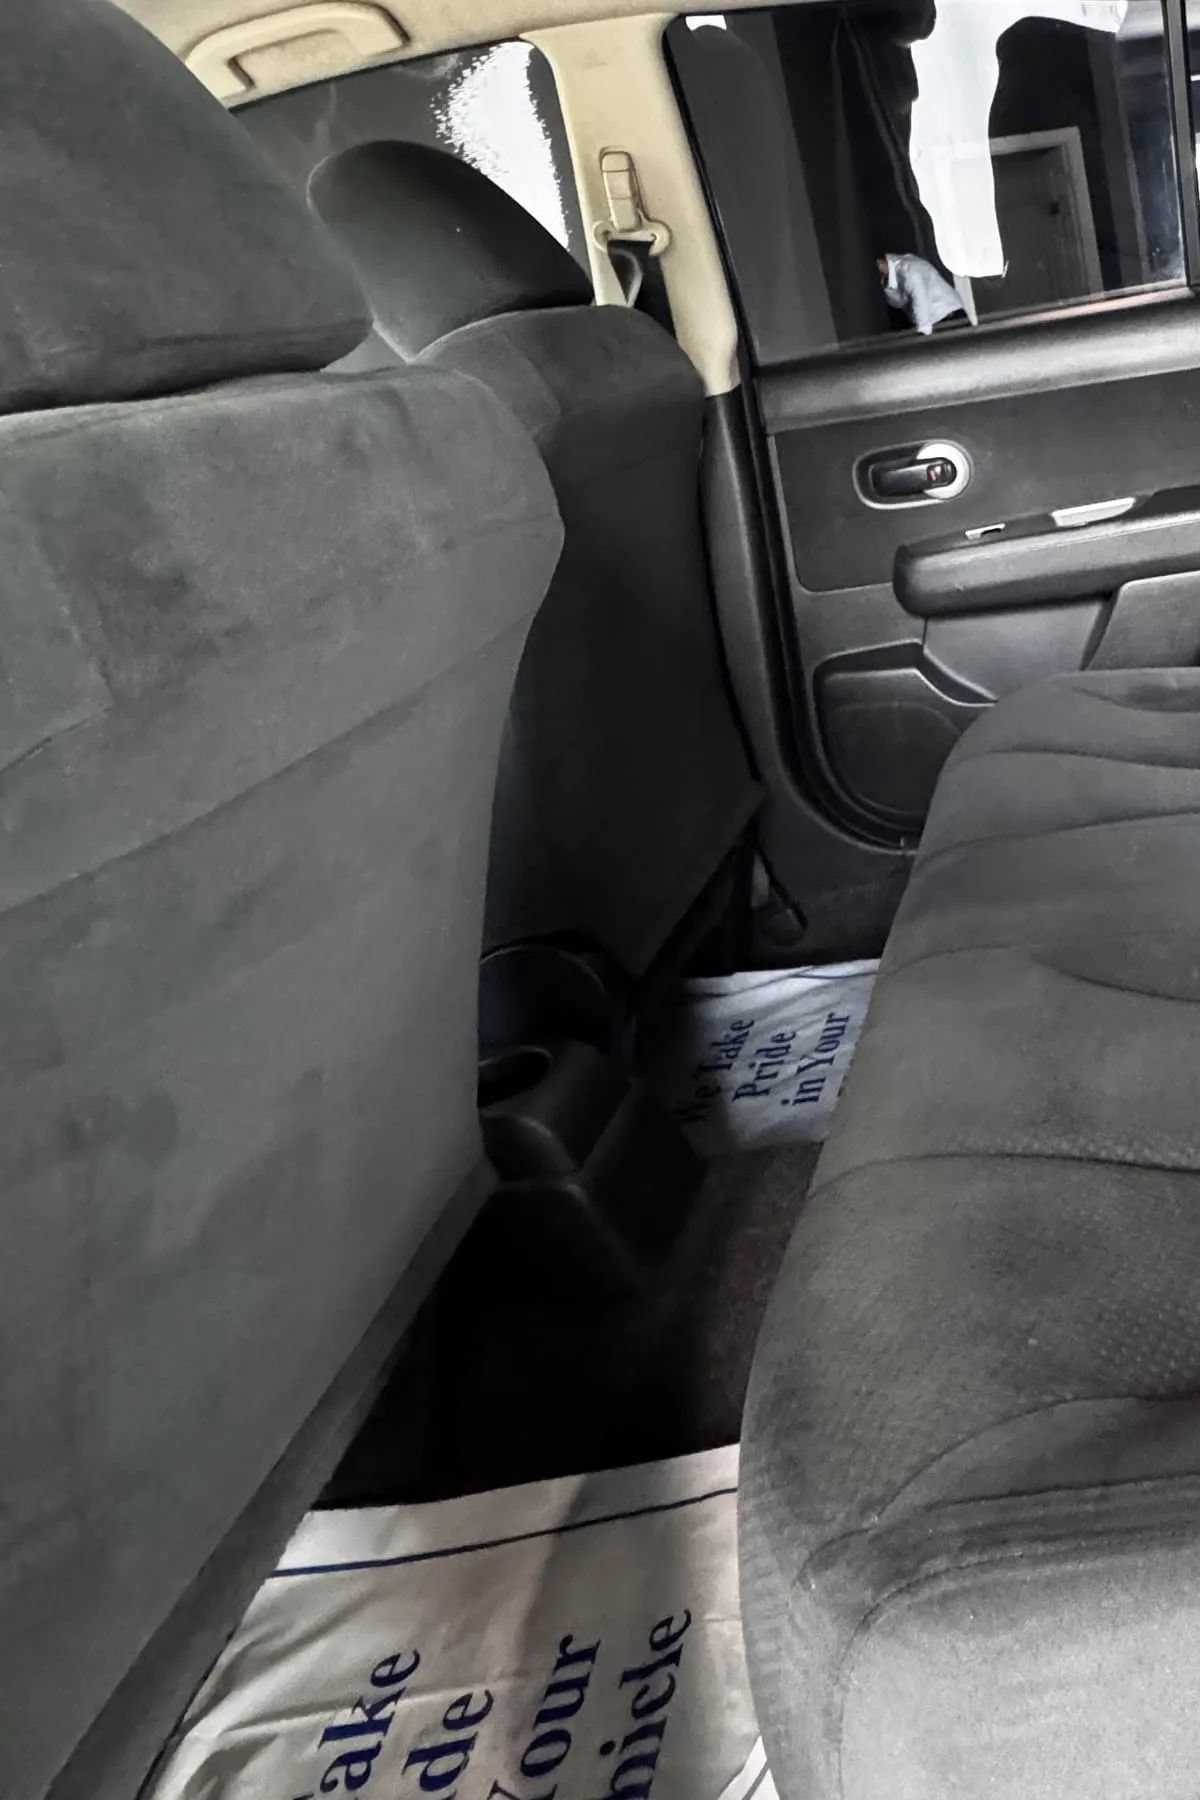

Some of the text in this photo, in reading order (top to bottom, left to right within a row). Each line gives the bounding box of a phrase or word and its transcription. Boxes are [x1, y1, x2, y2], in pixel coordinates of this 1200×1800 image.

[692, 1019, 755, 1079] Take
[732, 1031, 797, 1102] Pride
[780, 1012, 850, 1106] in Your
[294, 1649, 421, 1800] ake
[402, 1689, 494, 1800] de
